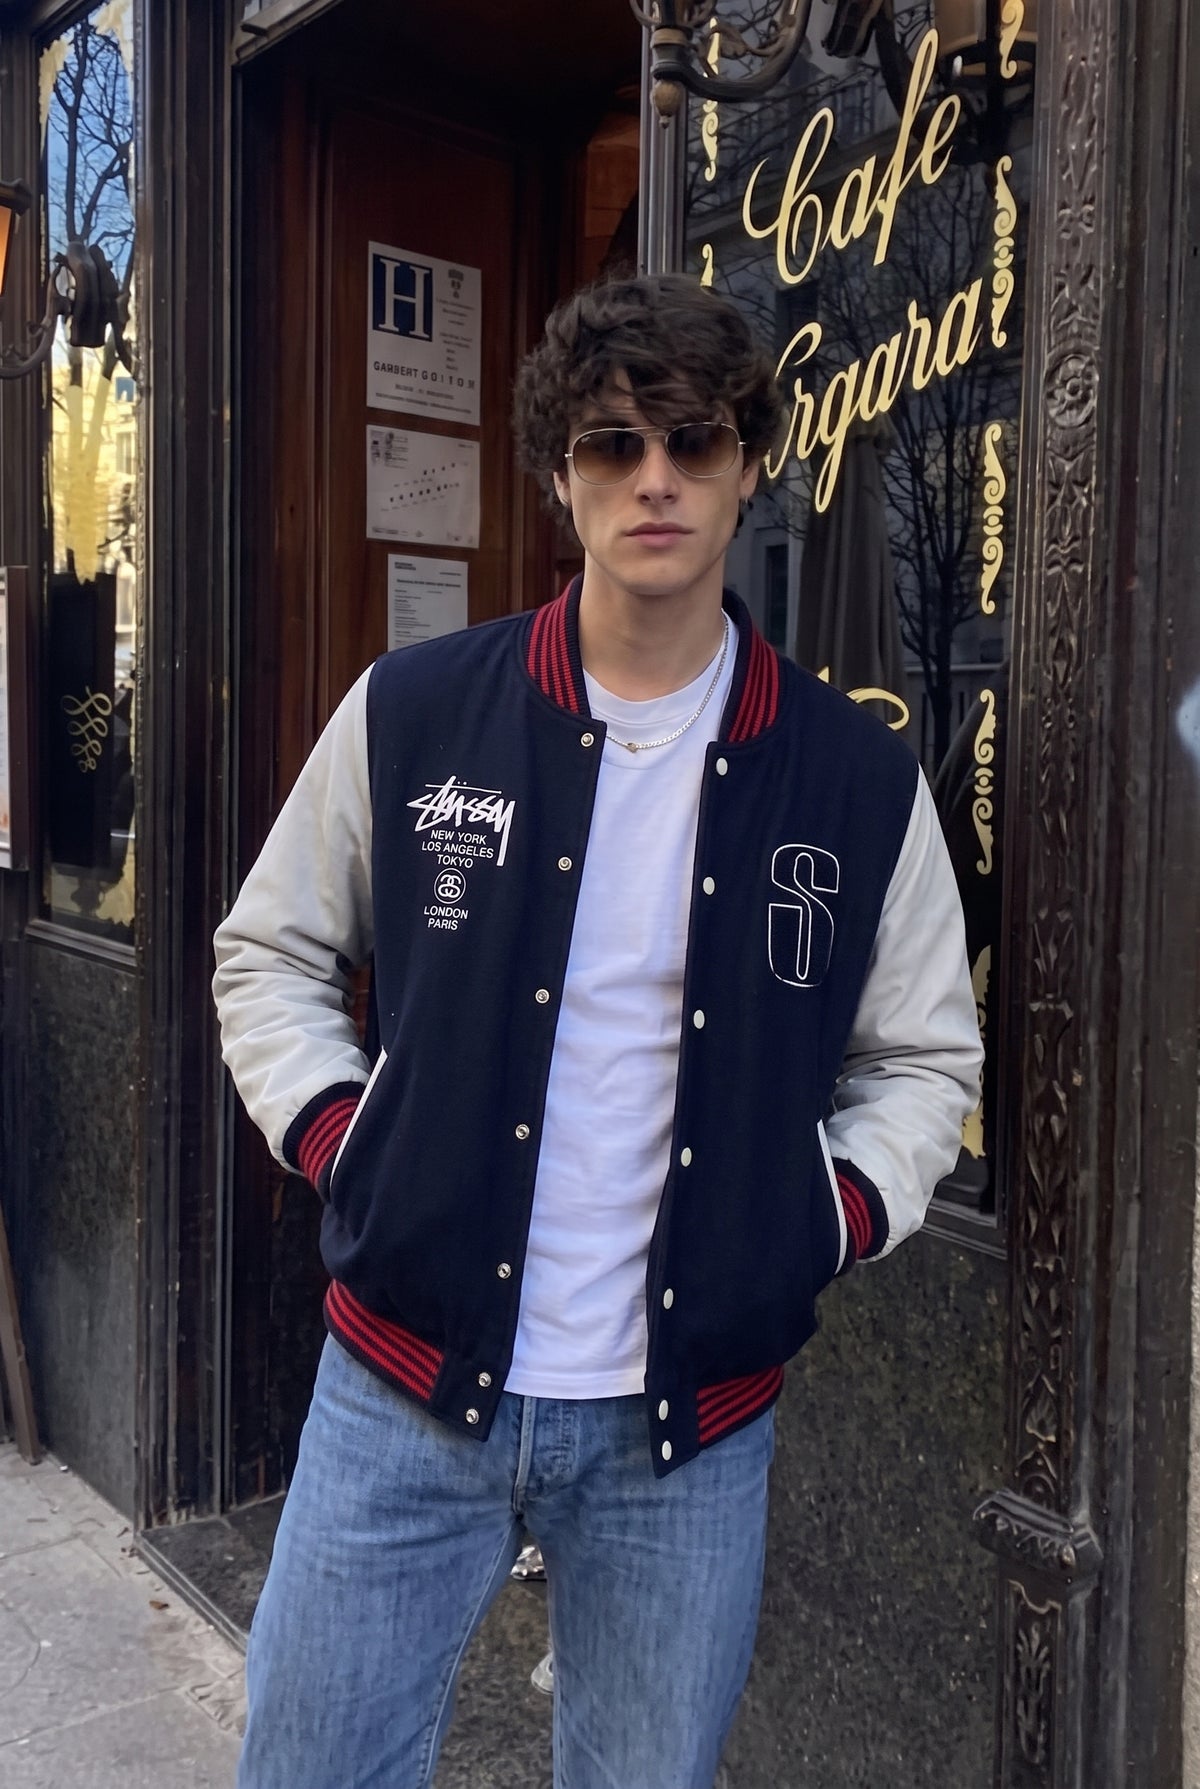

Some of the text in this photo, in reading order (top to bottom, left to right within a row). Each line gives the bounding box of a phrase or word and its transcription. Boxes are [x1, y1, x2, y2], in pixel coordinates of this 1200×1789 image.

[742, 28, 962, 284] Cafe
[378, 257, 431, 339] H
[764, 277, 984, 513] rgara
[430, 829, 487, 846] NEW YORK
[421, 841, 494, 859] LOS ANGELES
[436, 854, 474, 869] TOKYO
[423, 905, 469, 920] LONDON
[767, 843, 840, 988] S
[427, 917, 459, 931] PARIS
